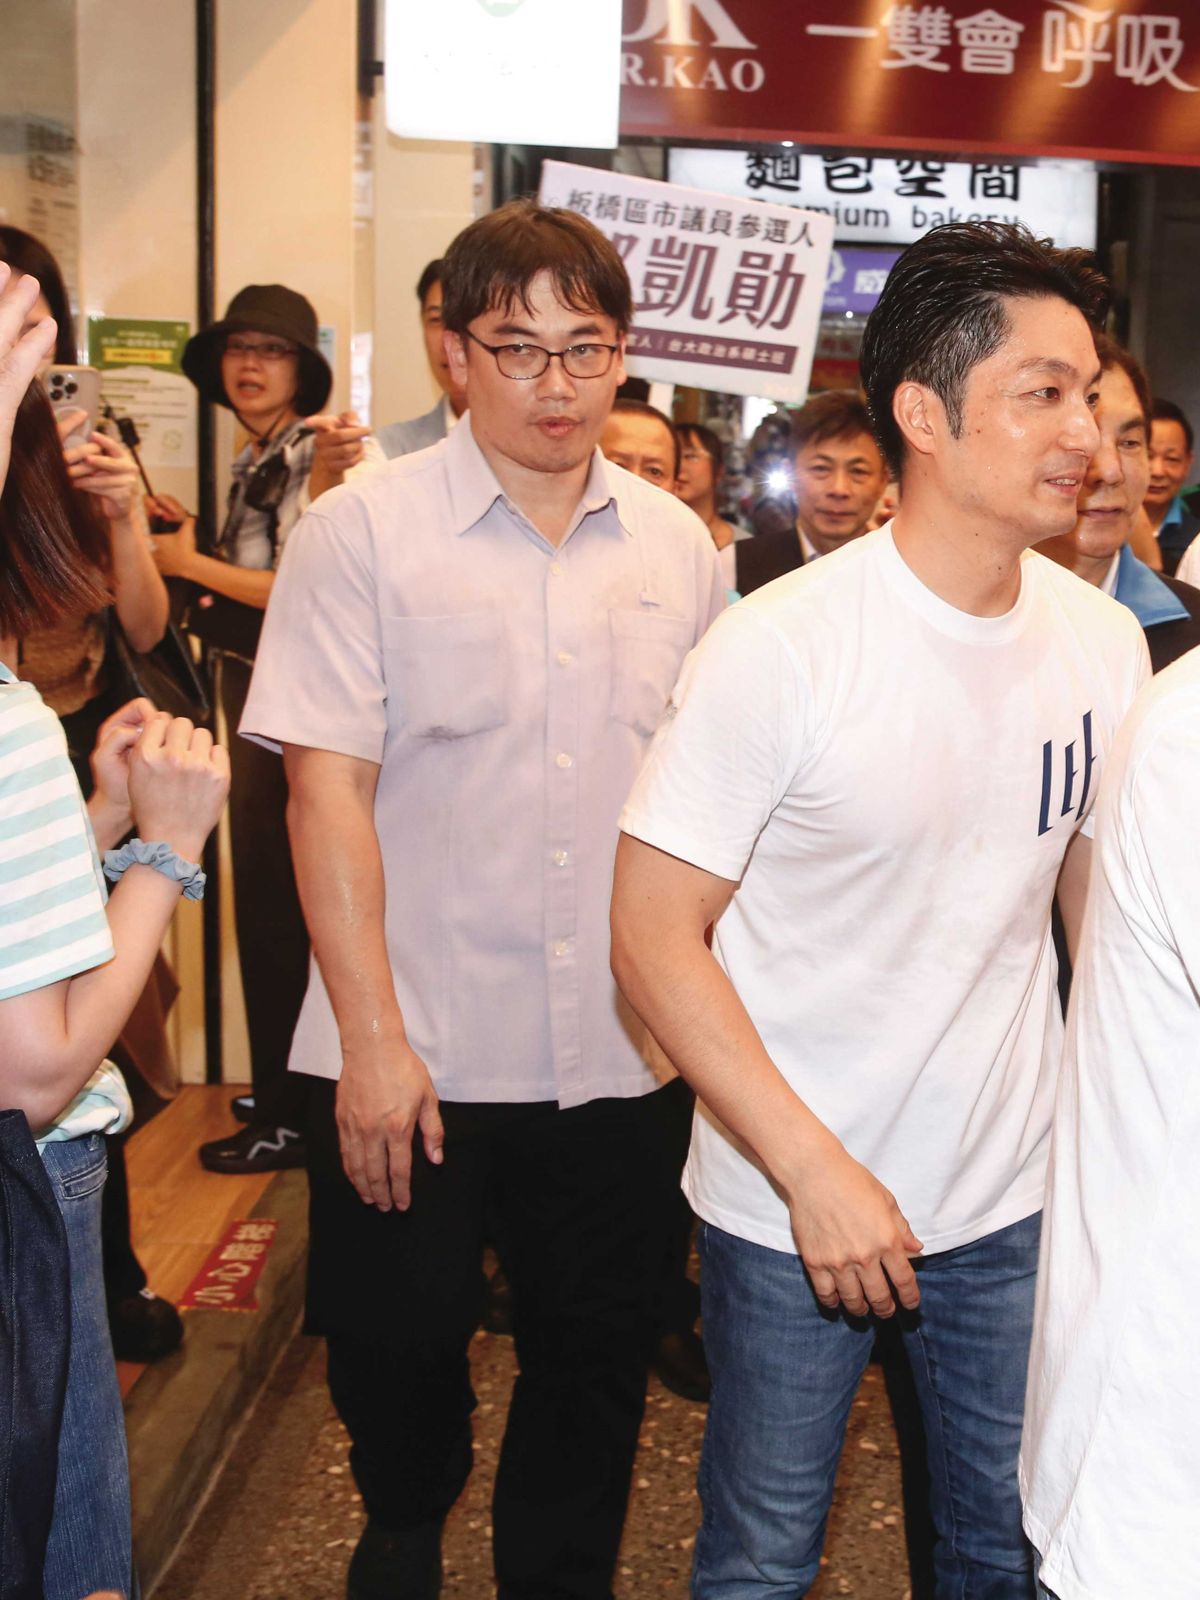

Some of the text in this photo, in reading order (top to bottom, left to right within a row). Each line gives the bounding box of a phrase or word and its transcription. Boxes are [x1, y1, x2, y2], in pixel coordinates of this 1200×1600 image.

[567, 188, 815, 248] 板橋區市議員參選人
[613, 232, 805, 330] 凱勛
